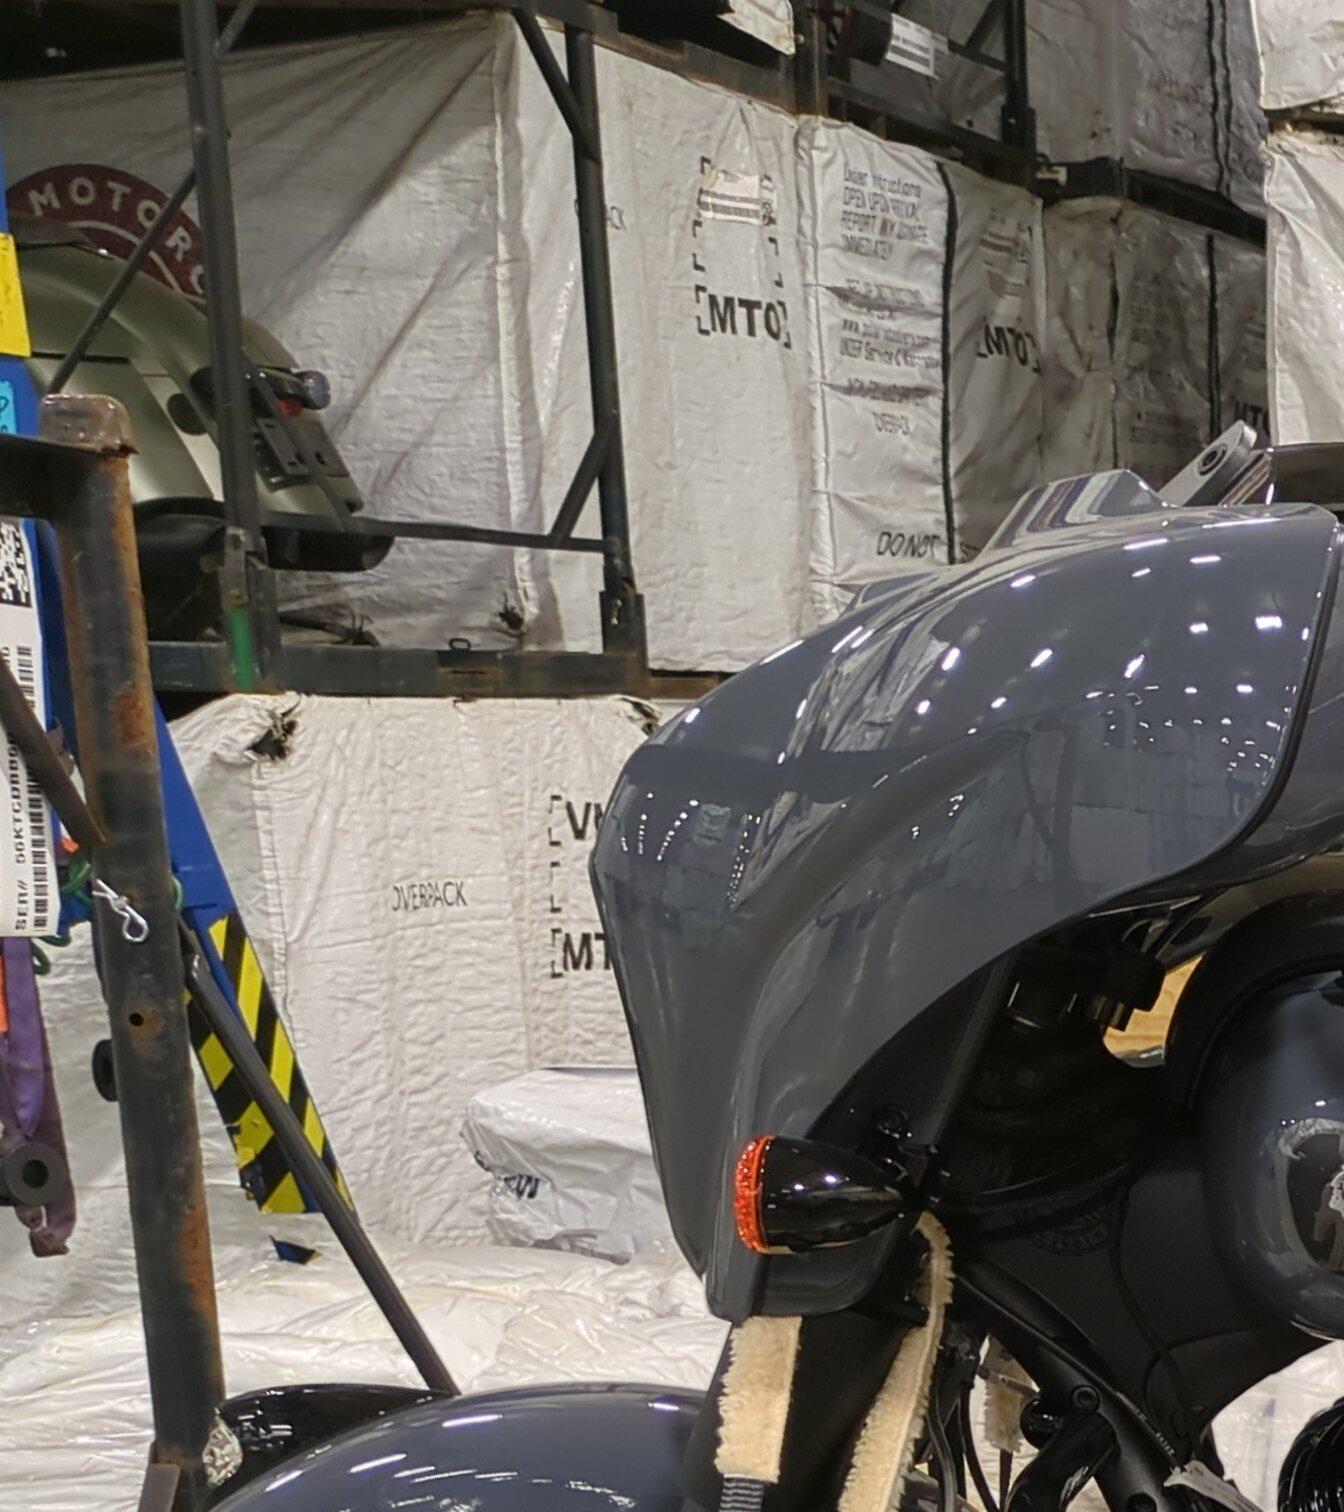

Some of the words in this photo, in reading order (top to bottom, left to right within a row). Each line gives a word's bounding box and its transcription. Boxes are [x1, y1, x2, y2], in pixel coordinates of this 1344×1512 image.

[27, 176, 206, 296] MOTORC
[708, 294, 781, 341] MTO
[563, 932, 612, 972] MT
